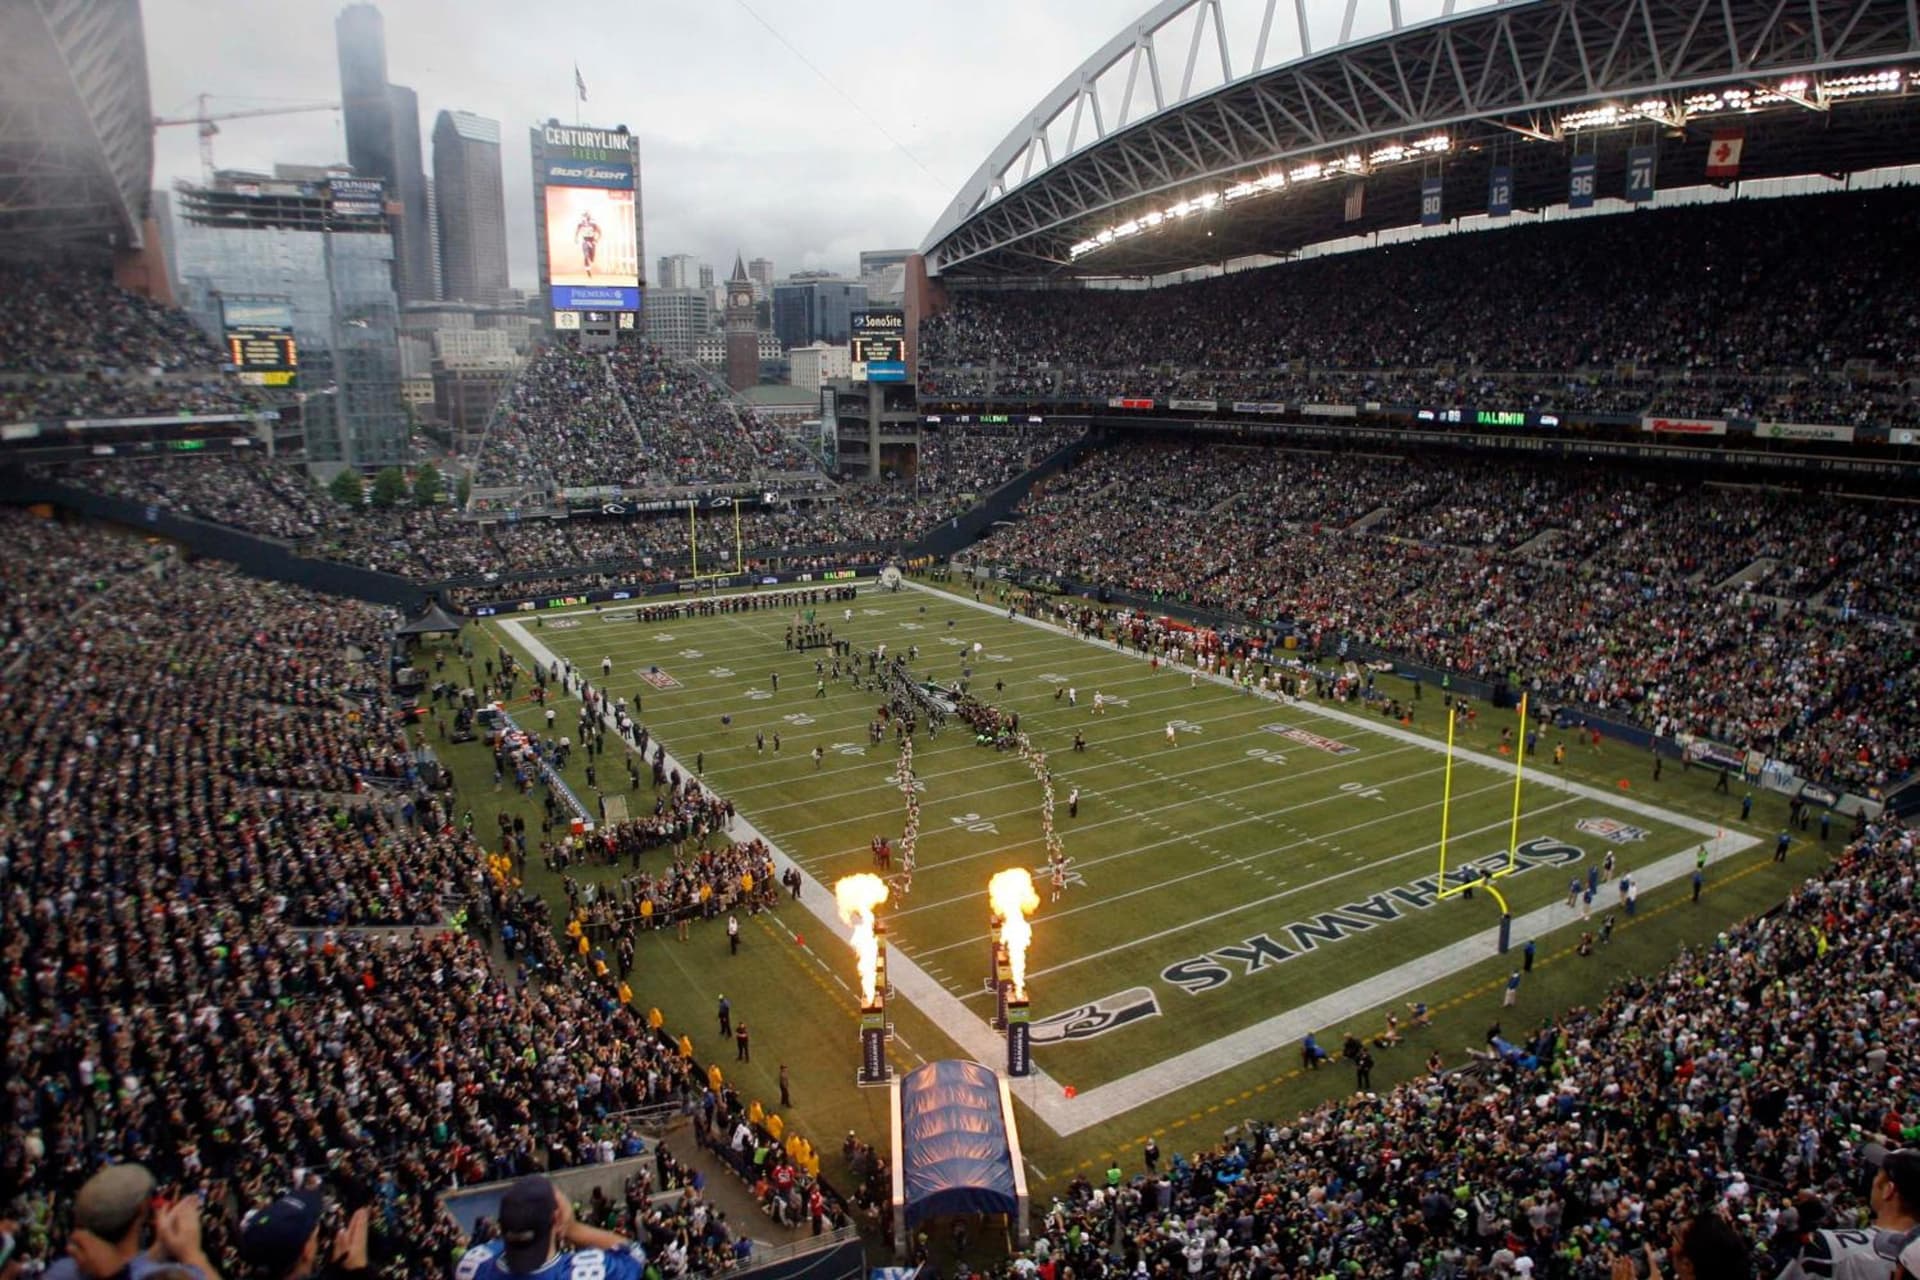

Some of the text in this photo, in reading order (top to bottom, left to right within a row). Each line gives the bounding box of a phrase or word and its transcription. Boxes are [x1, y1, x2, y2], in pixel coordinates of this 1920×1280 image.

[545, 127, 630, 151] CENTURYLINK
[572, 148, 607, 160] FIELD
[1571, 175, 1593, 197] 96
[1631, 168, 1650, 189] 71
[1424, 196, 1440, 214] 80
[1492, 185, 1509, 205] 12
[865, 315, 902, 327] SonoSite
[1477, 411, 1525, 425] BALDWIN
[1160, 836, 1586, 995] SEAHAWKS
